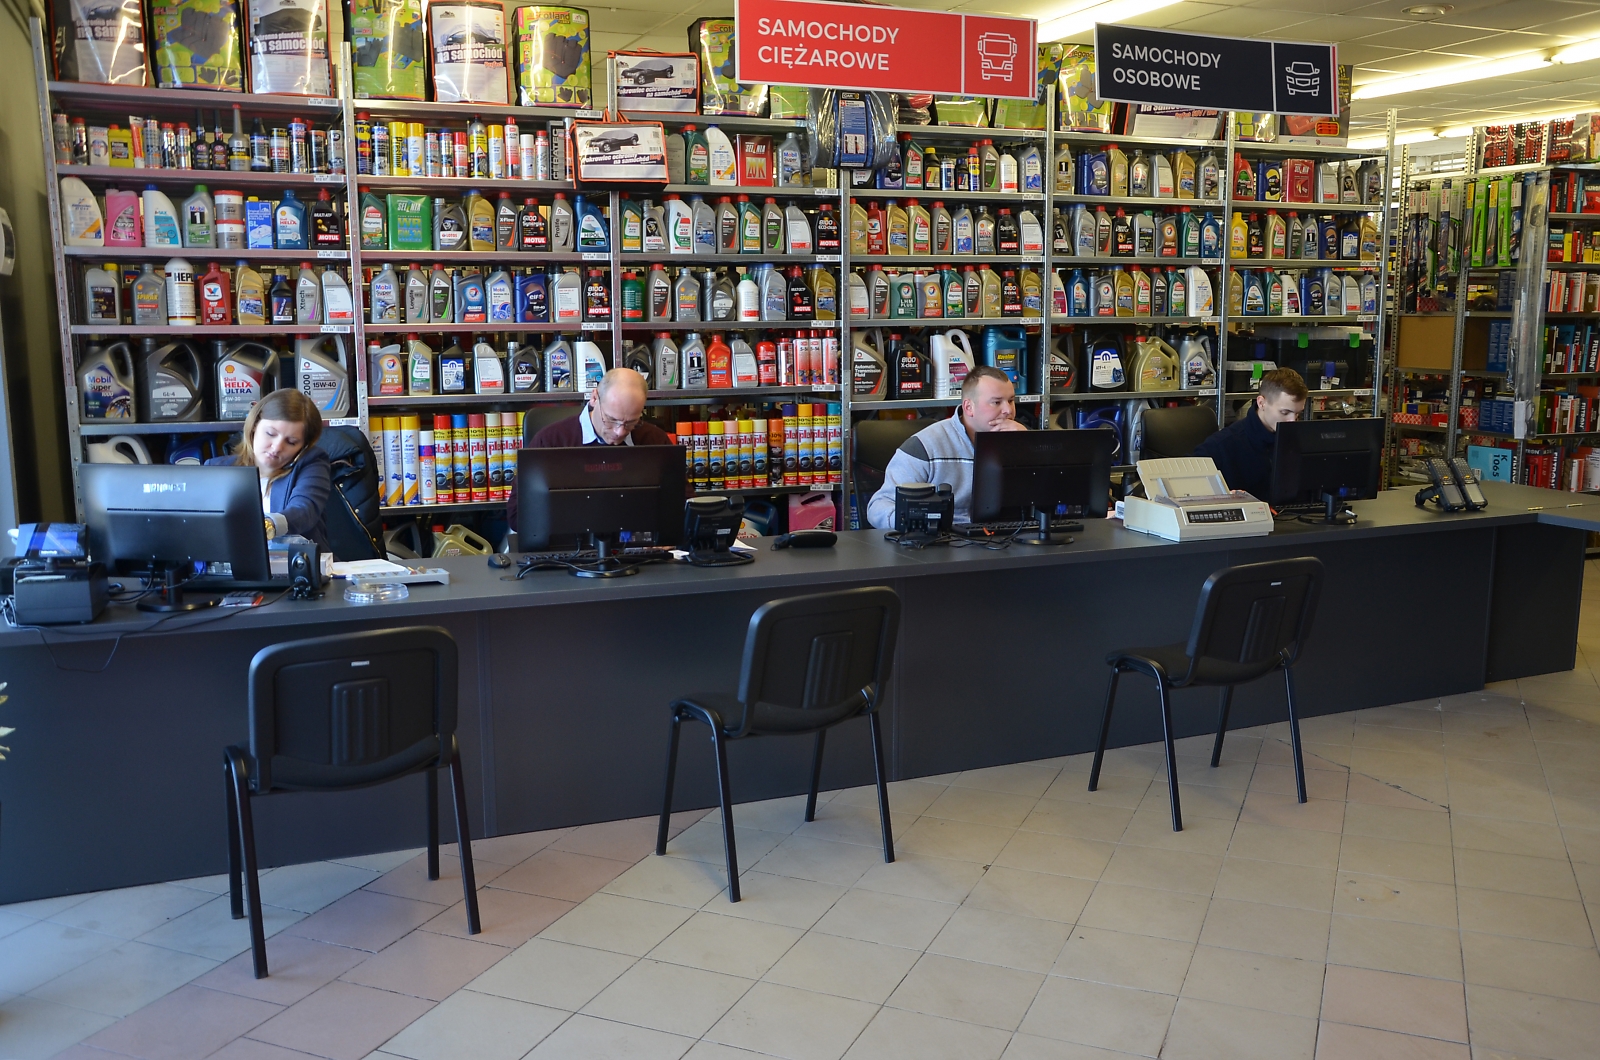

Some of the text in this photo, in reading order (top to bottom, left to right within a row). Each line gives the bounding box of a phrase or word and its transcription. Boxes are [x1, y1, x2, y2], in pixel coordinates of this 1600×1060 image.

[758, 18, 900, 45] SAMOCHODY
[758, 43, 890, 71] CIĘŻAROWE
[1112, 43, 1221, 69] SAMOCHODY
[1112, 68, 1202, 91] OSOBOWE
[1588, 339, 1599, 369] FILTRON
[88, 376, 111, 384] Mobil
[88, 384, 111, 392] Super
[224, 381, 254, 389] HELIX
[225, 387, 253, 395] ULTRA
[1492, 454, 1501, 478] 1065
[1501, 454, 1508, 462] K
[1550, 451, 1558, 489] FILTRON
